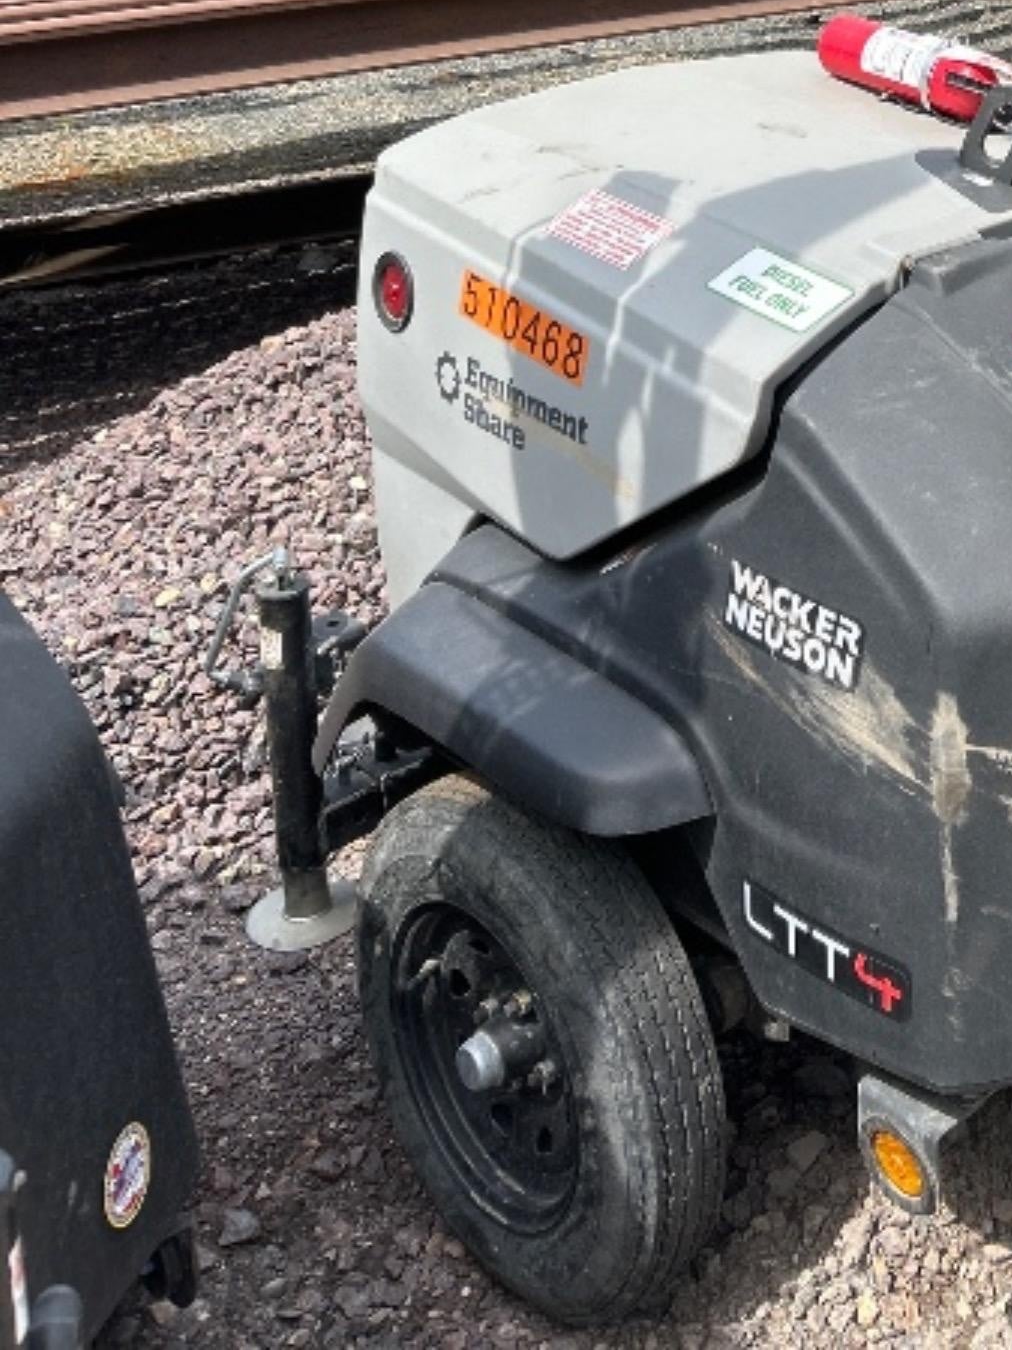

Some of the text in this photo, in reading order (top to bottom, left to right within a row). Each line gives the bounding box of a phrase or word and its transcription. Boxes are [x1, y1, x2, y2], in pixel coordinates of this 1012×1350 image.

[464, 272, 583, 379] 510468
[464, 356, 589, 445] Equipment
[464, 393, 526, 450] Share
[725, 592, 854, 688] NEUSON
[731, 559, 862, 656] WACKER
[743, 880, 903, 1013] LTT4
